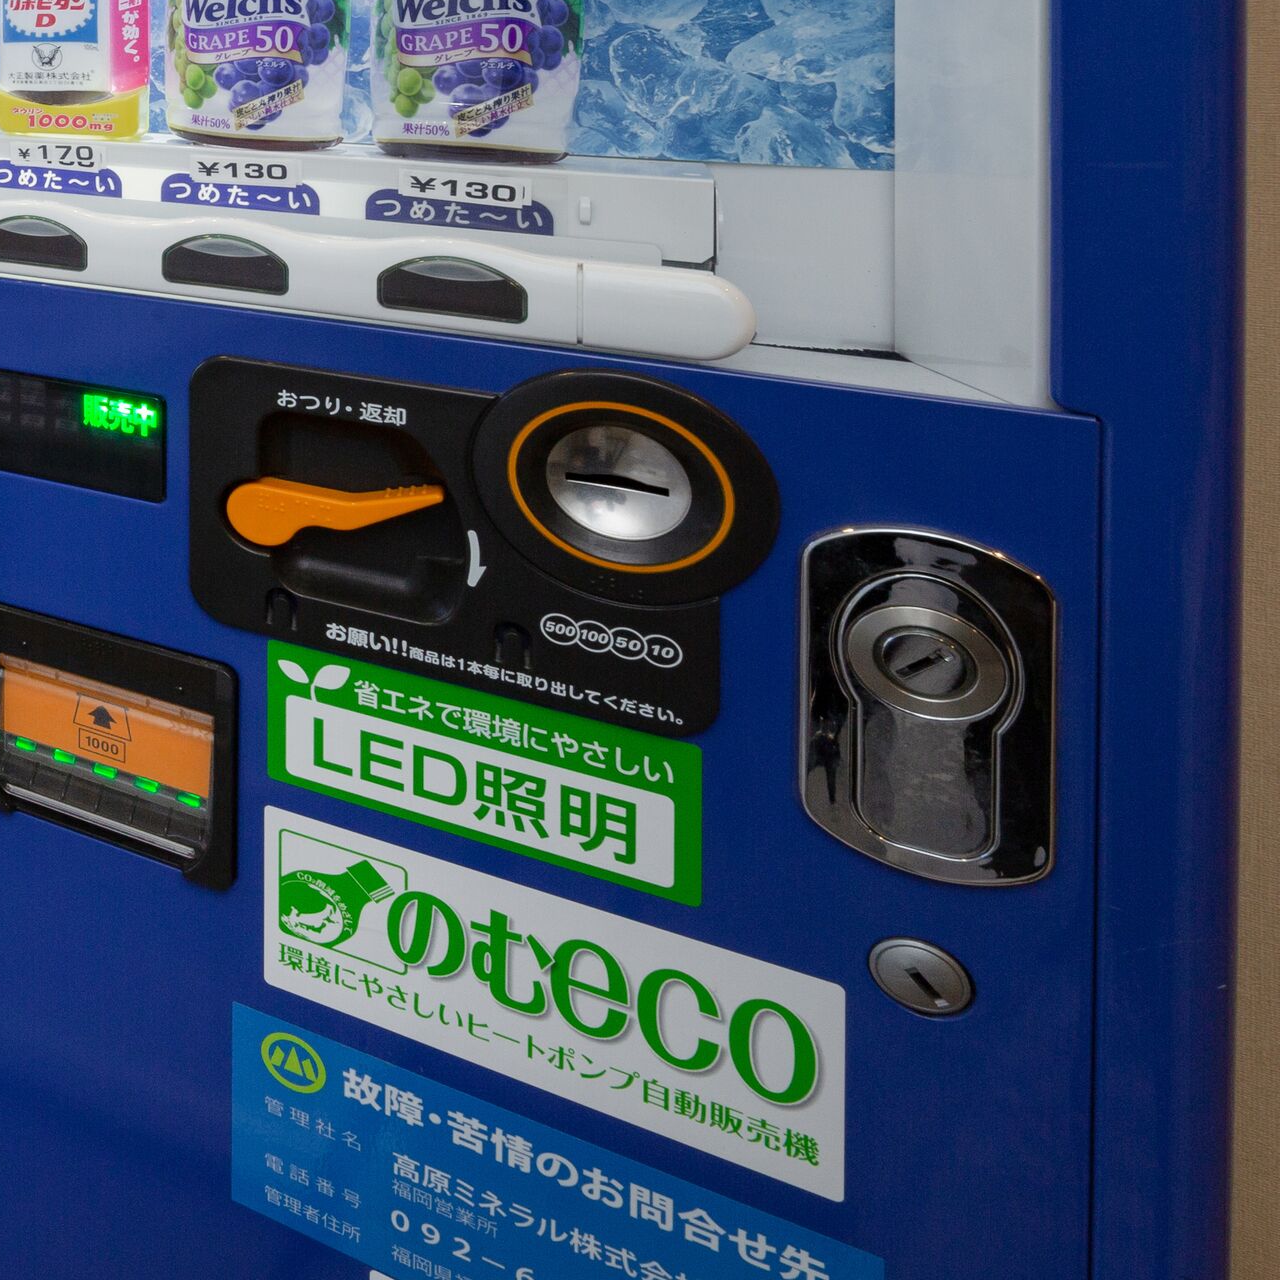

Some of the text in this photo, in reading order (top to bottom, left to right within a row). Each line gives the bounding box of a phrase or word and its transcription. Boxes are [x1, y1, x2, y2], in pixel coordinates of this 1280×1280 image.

[35, 13, 57, 29] D
[215, 17, 240, 27] SINCE
[434, 16, 462, 26] SINCE
[188, 24, 295, 53] GRAPE 50
[213, 48, 252, 61] グレープ
[254, 59, 287, 70] ウェルチ
[433, 48, 474, 64] グレープ
[478, 59, 515, 71] ウェルチ
[8, 70, 92, 83] 大正製薬株式会社
[235, 80, 303, 119] 皮ごと丸搾り果汁
[456, 83, 532, 122] 皮ごと丸搾り果汁
[27, 113, 114, 133] 1000mg
[191, 113, 231, 130] 果汁50%
[402, 122, 450, 138] 果汁50%
[17, 144, 95, 162] ¥170
[197, 161, 288, 180] ¥130
[83, 393, 159, 438] 販売中
[276, 389, 408, 427] おつり・返却
[543, 617, 676, 660] 500 100 50 10
[325, 622, 685, 727] お願い!! 商品は1本毎に取り出してください。
[84, 733, 120, 758] 1000
[352, 677, 676, 786] 省エネで環境にやさしい
[311, 716, 640, 867] LED照明
[386, 888, 820, 1108] のむeco
[277, 941, 821, 1169] 環境にやさしいヒートポンプ自動販売機
[263, 1094, 364, 1154] 管理社名
[263, 1151, 363, 1211] 電話番号
[341, 1068, 831, 1280] 故障・苦情のお問合せ先
[263, 1184, 363, 1246] 管理者住所
[391, 1177, 499, 1240] 福岡営業所
